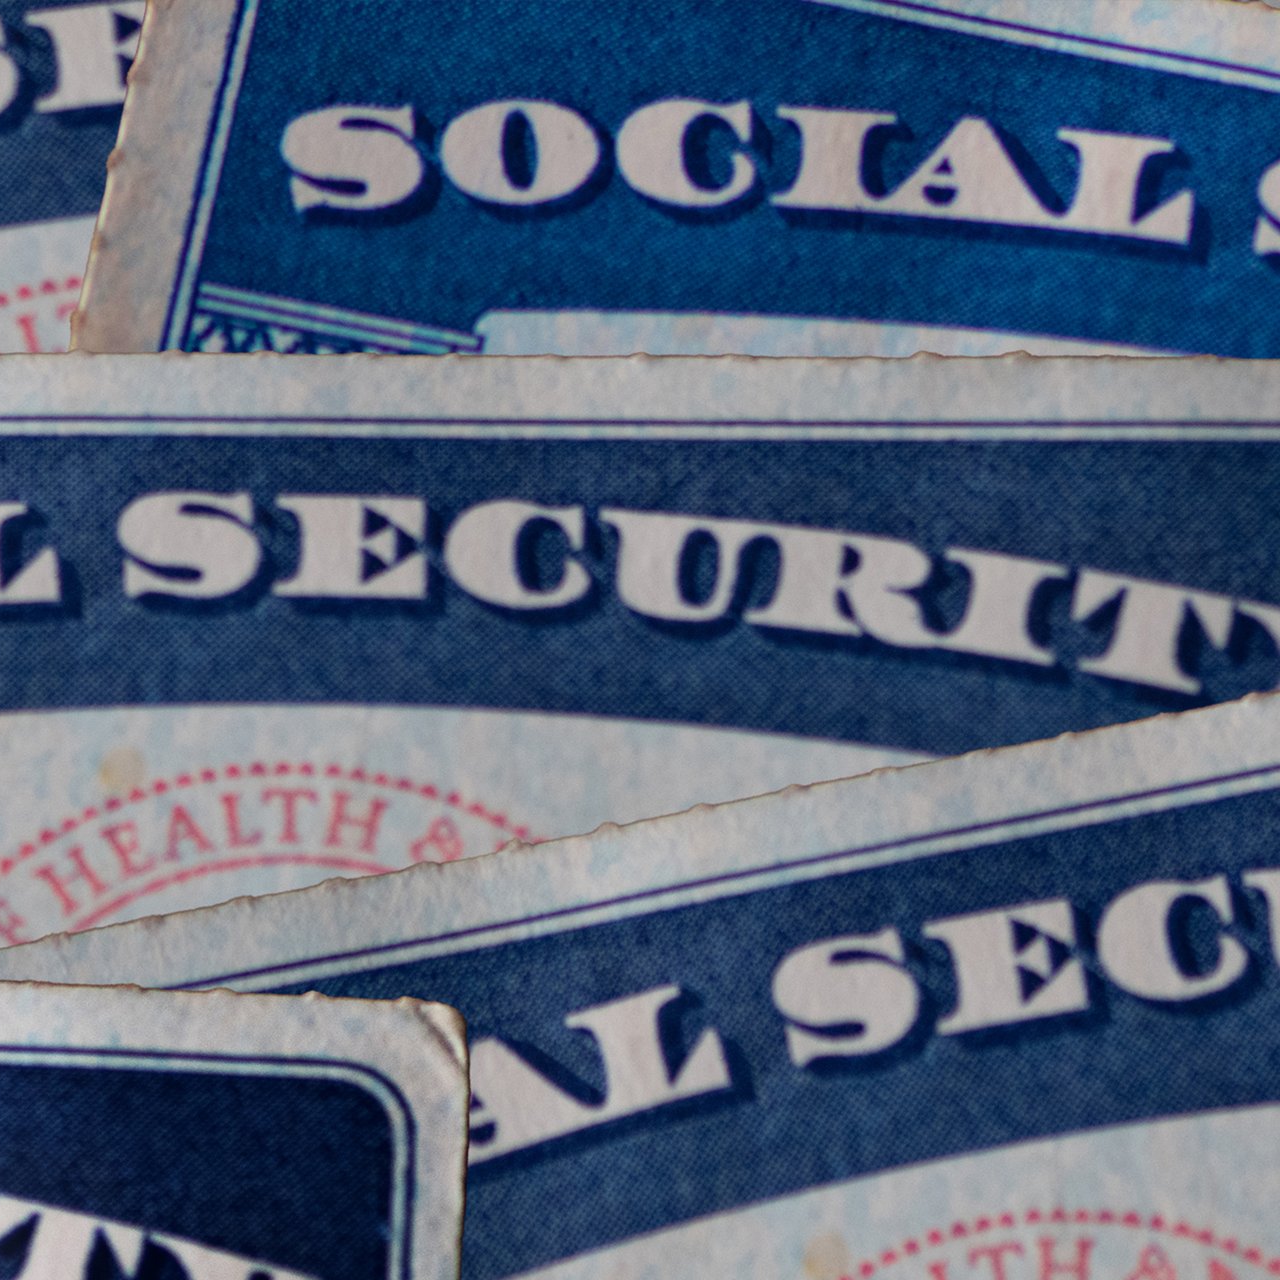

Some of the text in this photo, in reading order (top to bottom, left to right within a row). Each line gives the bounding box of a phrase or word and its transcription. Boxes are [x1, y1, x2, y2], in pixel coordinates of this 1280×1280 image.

[278, 98, 1195, 245] SOCIAL
[117, 490, 1280, 696] SECURIT
[32, 786, 391, 916] HEALTH
[771, 868, 1280, 1068] SEC
